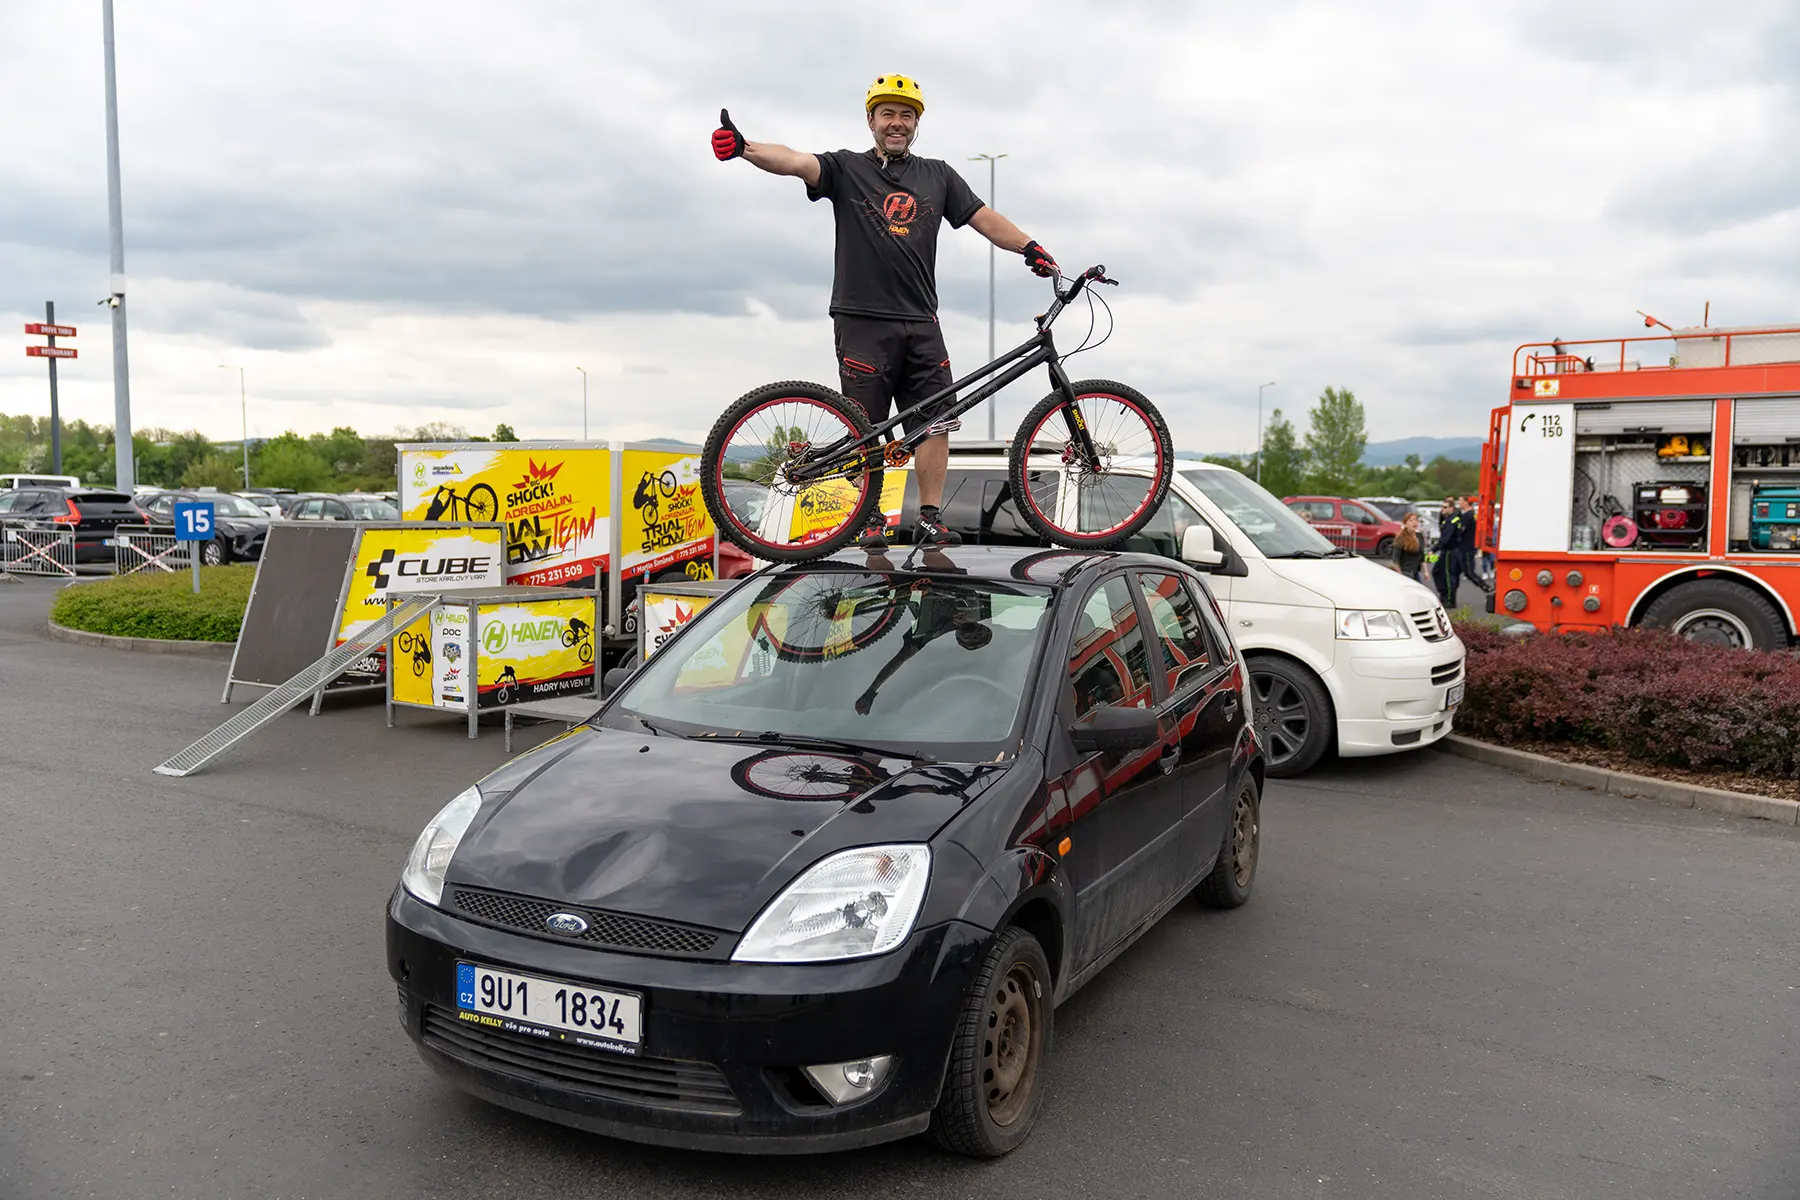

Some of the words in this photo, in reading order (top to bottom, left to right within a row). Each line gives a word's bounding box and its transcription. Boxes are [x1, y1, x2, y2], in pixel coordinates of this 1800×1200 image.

[41, 325, 57, 334] DRIVE
[58, 328, 73, 336] THRU
[41, 348, 74, 357] RESTAURANT
[1542, 414, 1561, 426] 112
[1541, 426, 1563, 438] 150
[1153, 457, 1170, 504] ROCKET
[506, 482, 554, 508] SHOCK!
[504, 494, 573, 521] ADRENALIN
[660, 506, 695, 521] ADRENALIN
[668, 498, 693, 512] SHOCK!
[183, 509, 209, 533] 15
[642, 518, 684, 540] TRIAL
[680, 513, 706, 540] TEAM
[540, 506, 596, 558] TEAM
[641, 529, 685, 554] SHOW
[397, 557, 490, 576] CUBE
[636, 563, 654, 573] Martin
[680, 549, 689, 558] 775
[689, 546, 698, 554] 231
[439, 574, 469, 582] KARLOVY
[530, 573, 546, 586] 775
[547, 569, 563, 581] 231
[564, 564, 583, 577] 509
[446, 613, 469, 624] HAVEN
[511, 620, 564, 642] HAVEN
[533, 681, 559, 693] HADRY
[559, 681, 570, 689] NA
[570, 679, 584, 688] VEN
[553, 916, 578, 930] Ford
[460, 991, 473, 1004] CZ
[481, 974, 528, 1016] 9U1
[555, 988, 625, 1034] 1834
[459, 1012, 479, 1023] AUTO
[480, 1016, 503, 1028] KELLY
[576, 1037, 636, 1054] www.autokelly.cz
